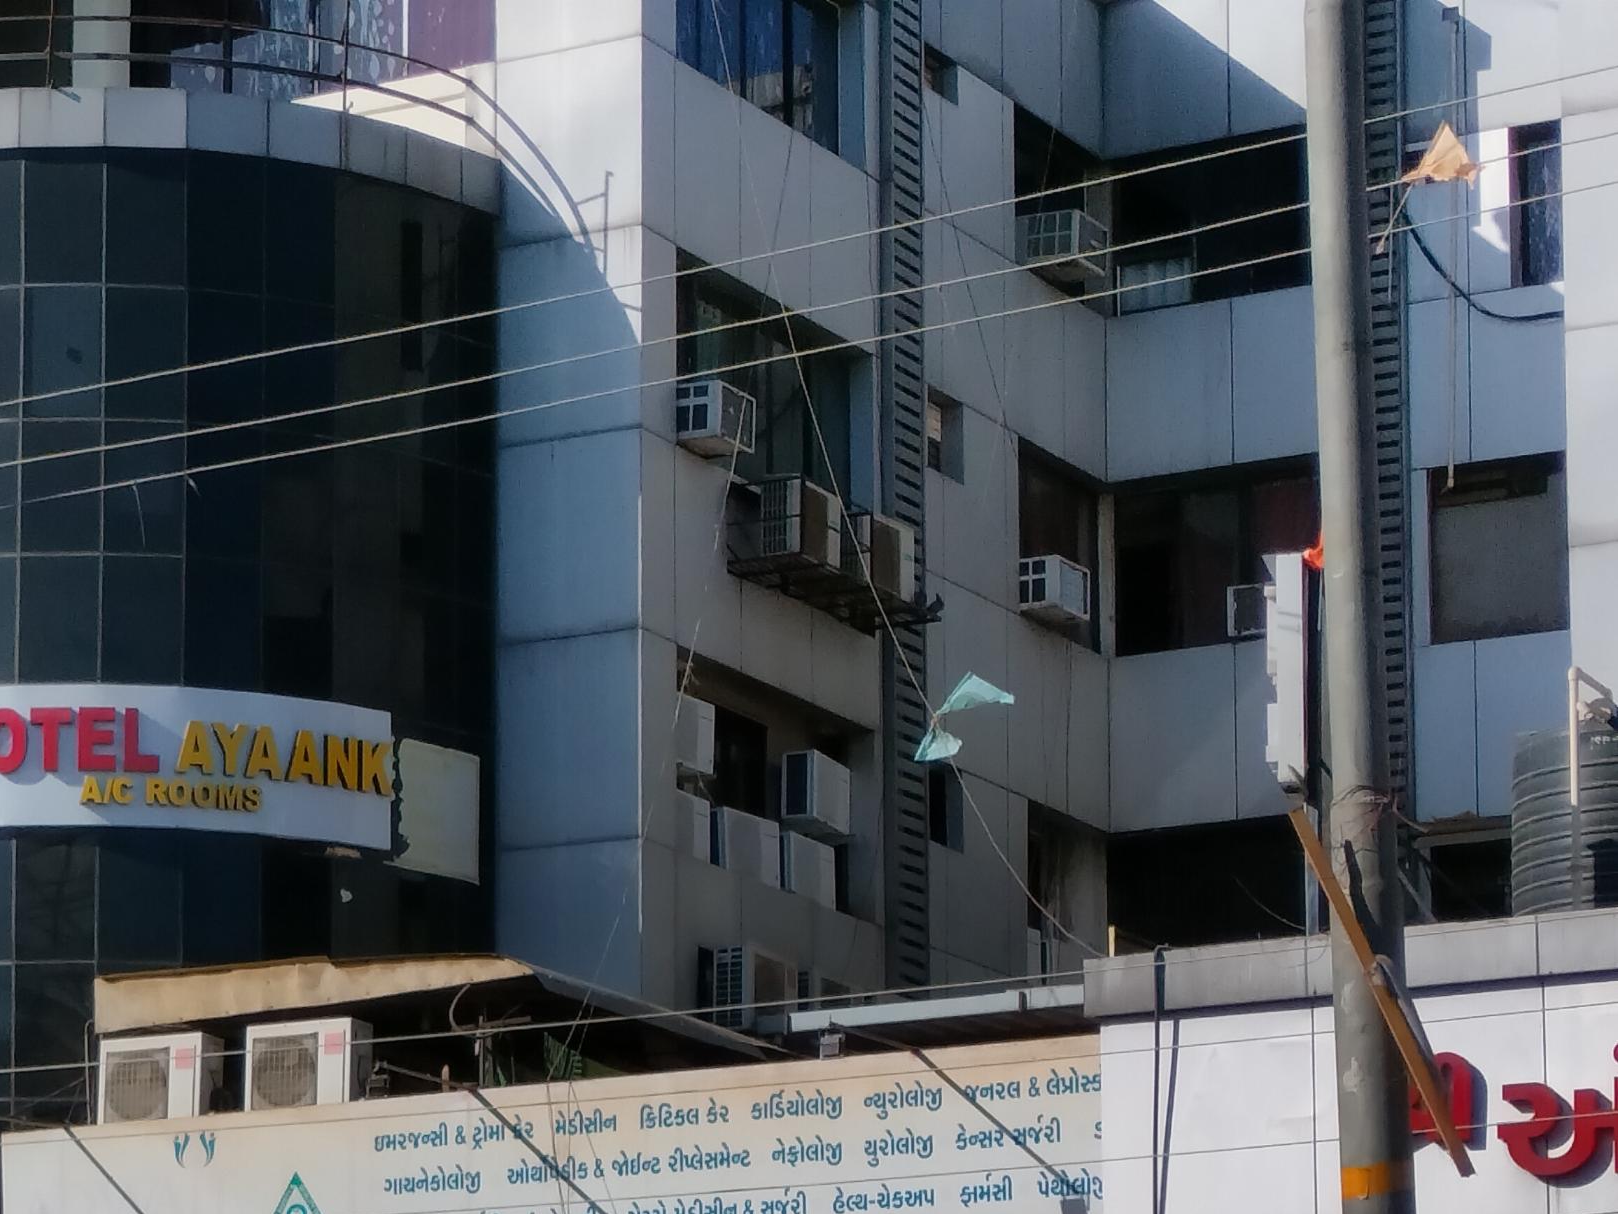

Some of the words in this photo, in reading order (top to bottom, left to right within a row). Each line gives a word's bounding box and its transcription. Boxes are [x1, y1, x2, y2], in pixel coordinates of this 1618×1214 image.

[175, 720, 391, 796] AYAANK
[80, 777, 134, 806] A/C
[146, 781, 262, 812] ROOMS
[455, 1124, 467, 1145] &
[555, 1108, 617, 1135] મેડીસીન
[706, 1097, 730, 1124] કેર
[1028, 1076, 1041, 1098] &
[593, 1158, 605, 1178] &
[863, 1128, 934, 1168] યુરોલોજી
